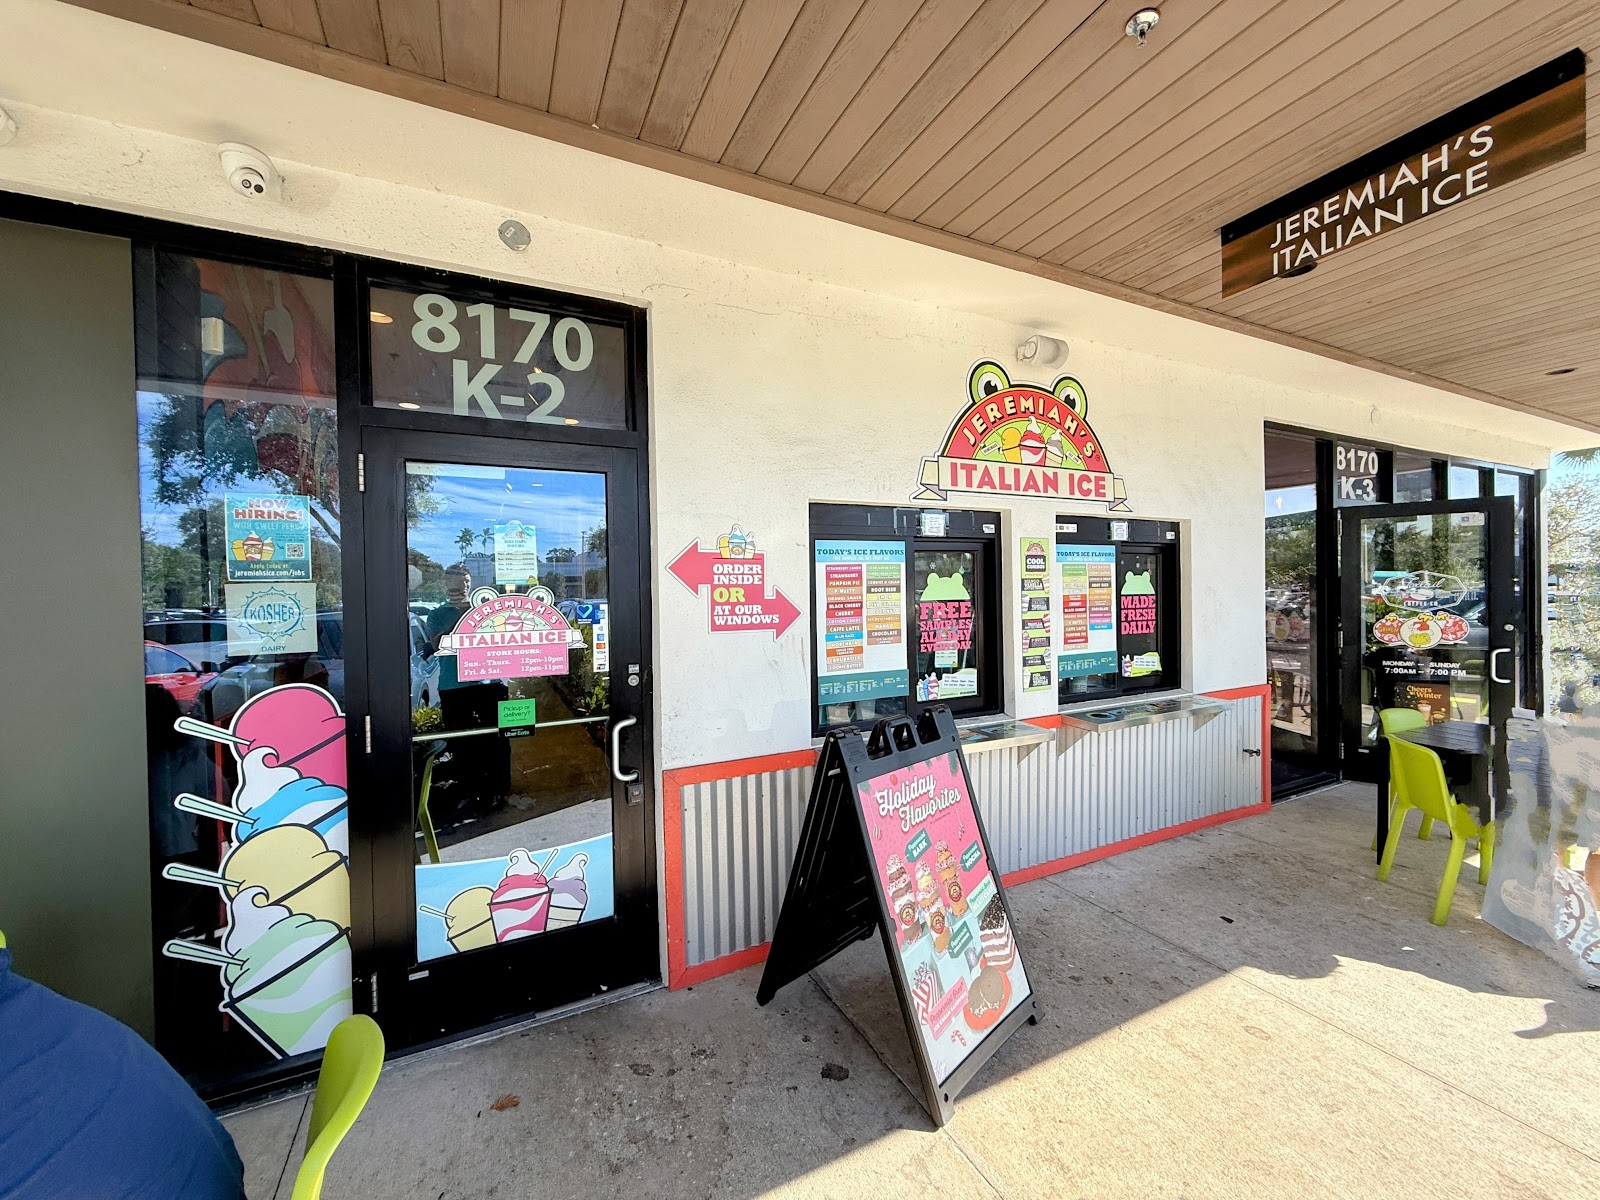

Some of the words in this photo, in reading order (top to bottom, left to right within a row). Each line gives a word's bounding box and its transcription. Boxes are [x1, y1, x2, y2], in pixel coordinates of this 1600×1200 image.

[1270, 125, 1494, 248] JEREMIAH'S
[1272, 198, 1403, 276] ITALIAN
[1421, 161, 1489, 214] ICE
[411, 293, 594, 372] 8170
[452, 358, 567, 426] K-2
[962, 394, 1095, 459] JEREMIAH'S
[1336, 446, 1378, 475] 8170
[950, 462, 1059, 494] ITALIAN
[1068, 473, 1107, 498] ICE
[1341, 476, 1375, 501] K-3
[248, 497, 290, 509] NOW
[233, 522, 251, 530] WITH
[255, 522, 280, 531] SWEET
[234, 568, 306, 578] jeremiahsice.com/jobs
[712, 564, 762, 574] ORDER
[713, 575, 762, 585] INSIDE
[713, 587, 745, 603] OR
[1121, 596, 1156, 608] MADE
[250, 603, 295, 625] KOSHER
[467, 599, 560, 628] JEREMIAH'S
[714, 605, 731, 615] AT
[735, 605, 762, 614] OUR
[919, 602, 972, 620] FREE
[1121, 608, 1156, 621] FRESH
[714, 614, 779, 625] WINDOWS
[919, 619, 971, 631] SAMPLES
[1121, 621, 1156, 635] DAILY
[458, 633, 532, 647] ITALIAN
[538, 631, 567, 643] ICE
[920, 631, 947, 643] ALL
[948, 629, 972, 642] DAY
[261, 645, 286, 653] DAIRY
[920, 641, 954, 652] EVERY
[954, 640, 972, 650] DAY
[488, 667, 502, 675] Sat.
[1406, 685, 1432, 693] Cheers
[1416, 691, 1442, 699] Winter
[503, 705, 523, 713] Pickup
[503, 710, 531, 718] delivery?
[875, 773, 937, 816] Holiday
[899, 787, 961, 832] Flavorites
[912, 840, 928, 858] BARK
[964, 850, 981, 869] MOCHA
